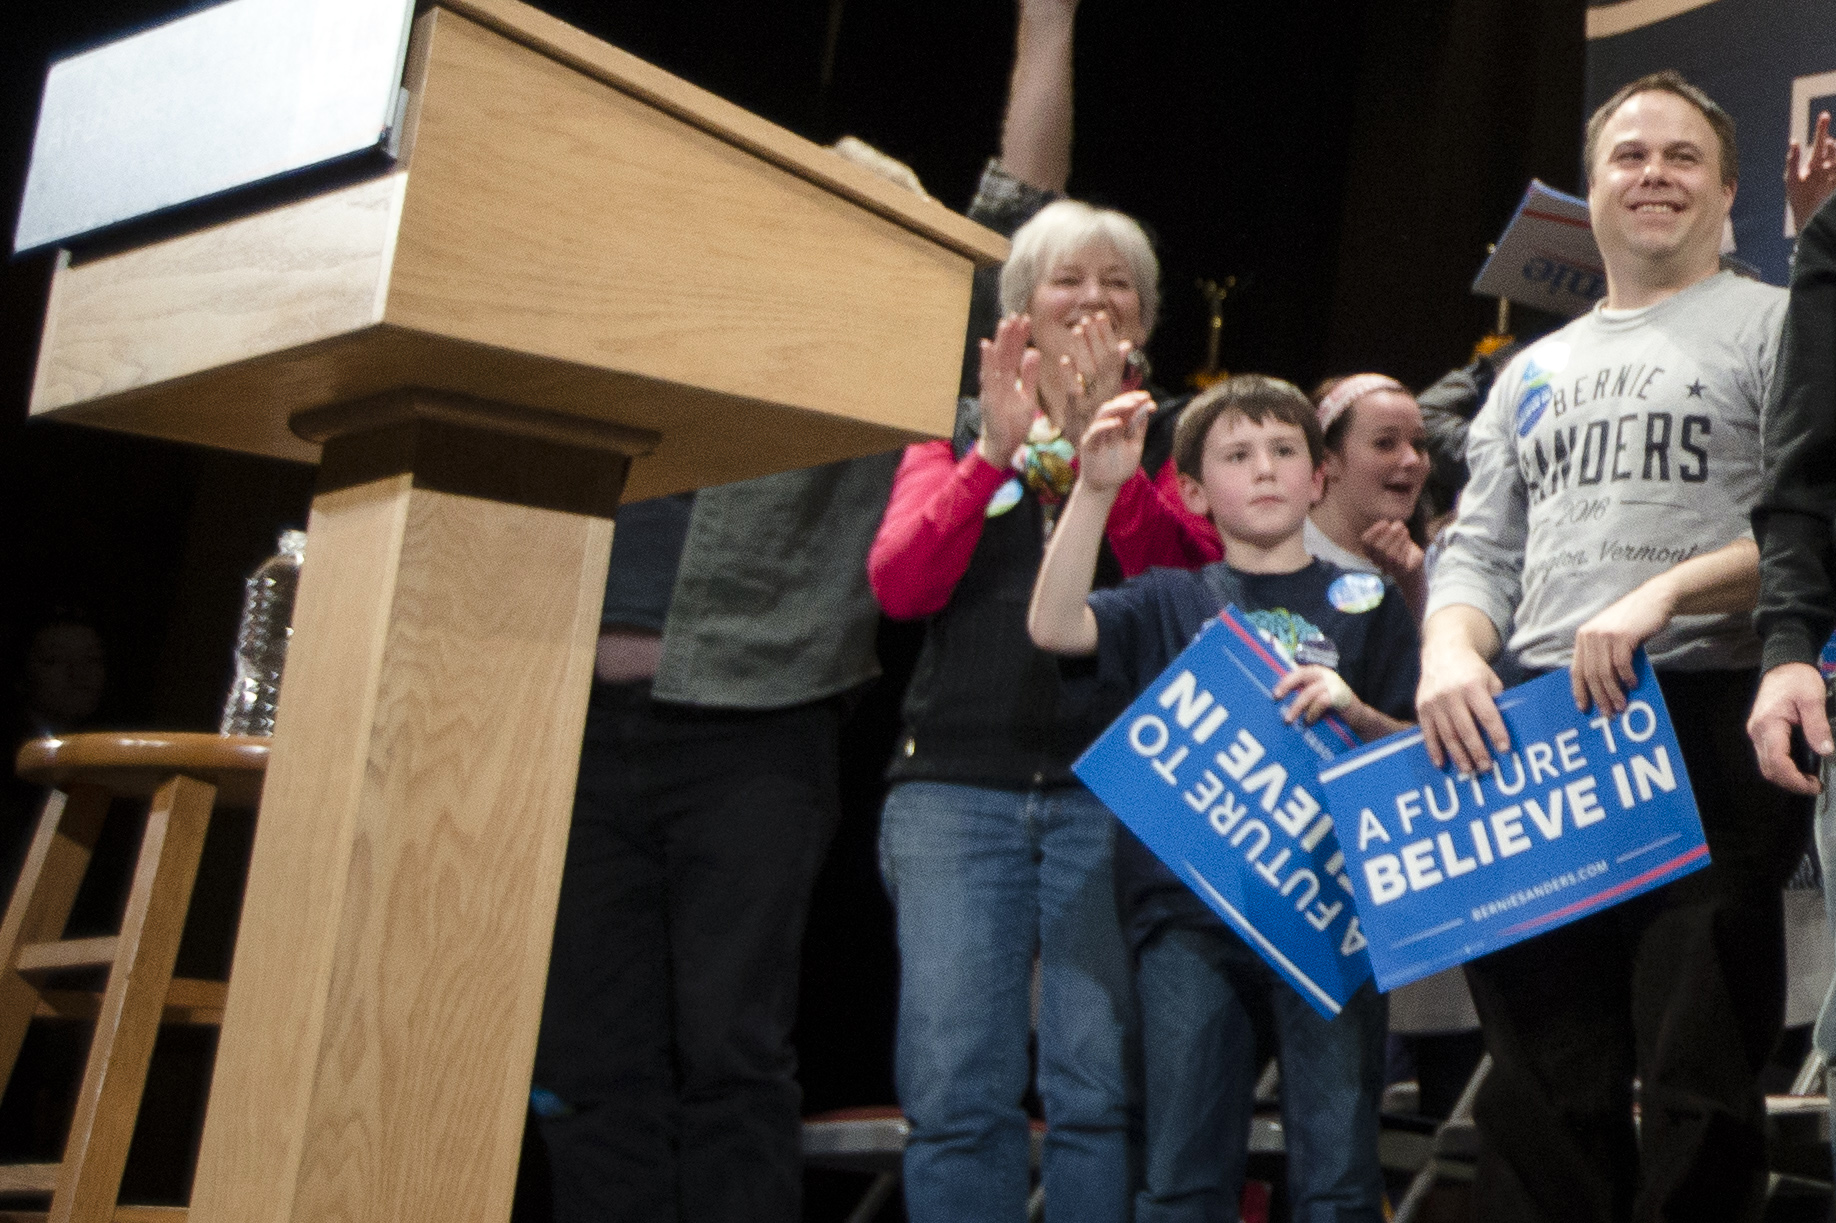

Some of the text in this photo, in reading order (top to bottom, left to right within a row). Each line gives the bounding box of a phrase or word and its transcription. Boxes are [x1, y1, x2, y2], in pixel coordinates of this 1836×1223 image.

[1552, 363, 1666, 419] BERNIE
[1600, 539, 1699, 566] Vermont
[1157, 668, 1230, 746] IN
[1358, 806, 1391, 852] A
[1395, 727, 1589, 835] FUTURE
[1588, 699, 1657, 755] TO
[1128, 714, 1368, 957] A FUTURE TO
[1362, 744, 1678, 907] BELIEVE IN
[1471, 858, 1610, 923] BERNIESANDERS.COM
